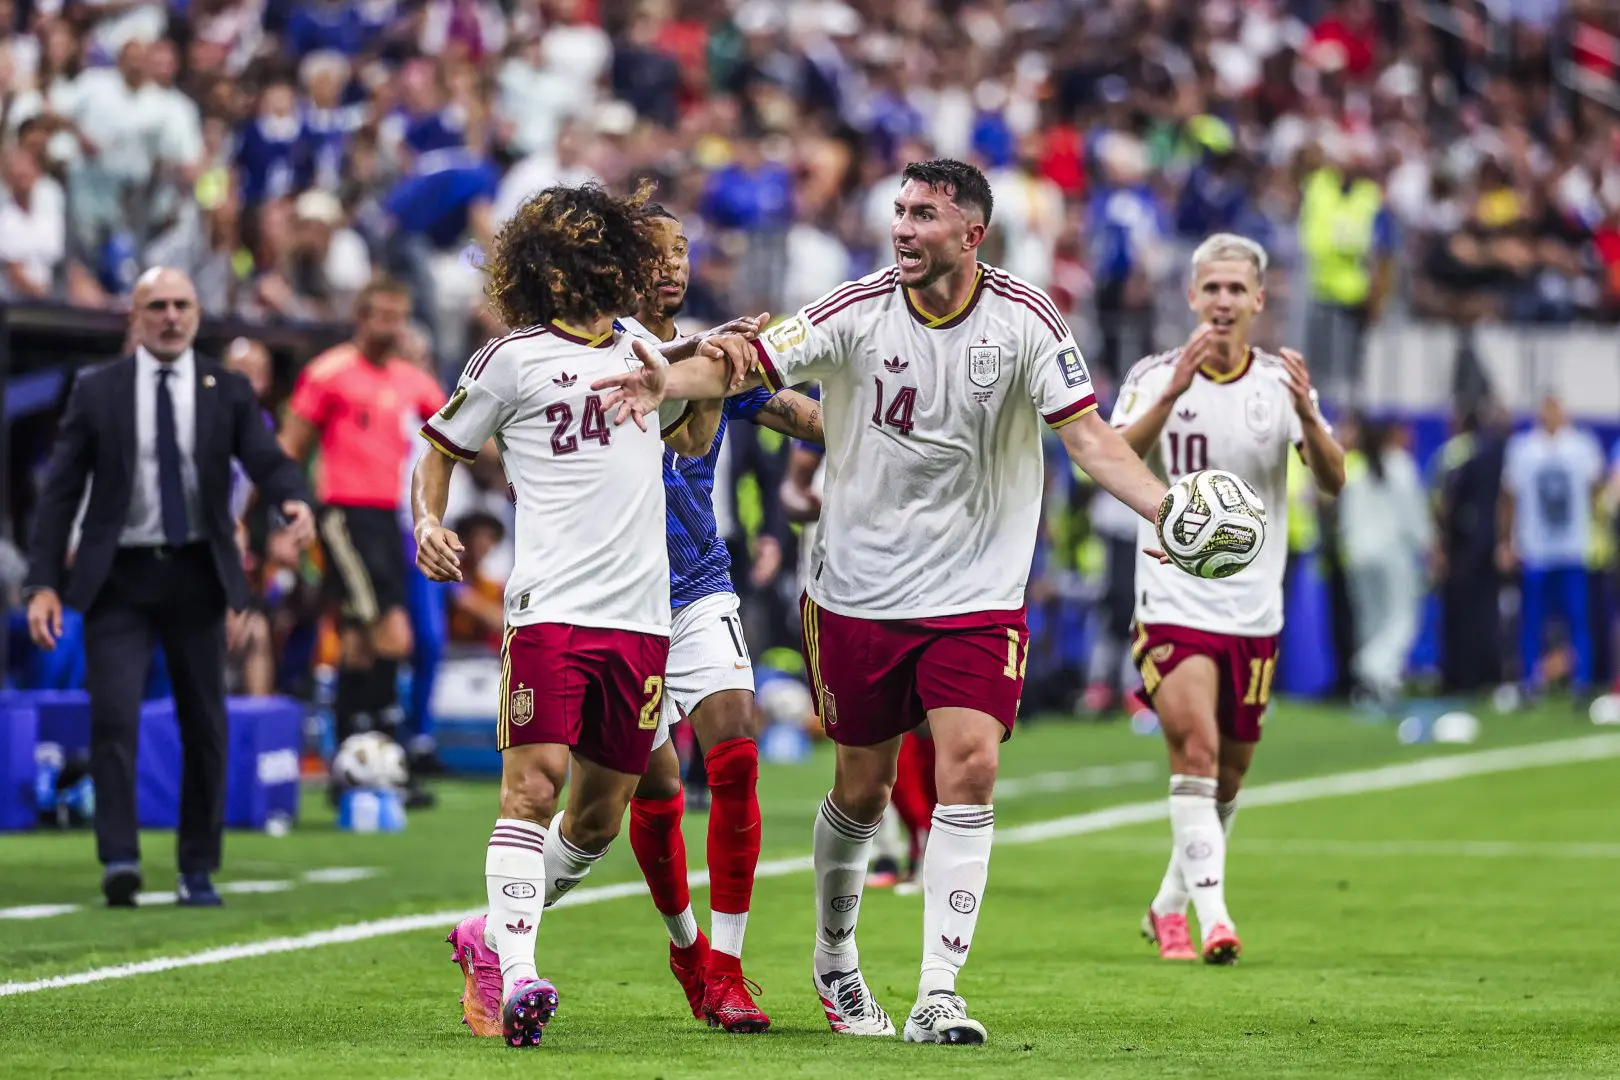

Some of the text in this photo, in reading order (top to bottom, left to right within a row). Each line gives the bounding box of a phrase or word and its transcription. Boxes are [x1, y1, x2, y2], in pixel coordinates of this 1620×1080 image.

[545, 394, 611, 457] 24
[872, 377, 917, 436] 14
[1168, 432, 1208, 475] 10
[1223, 525, 1253, 538] TRIONDA
